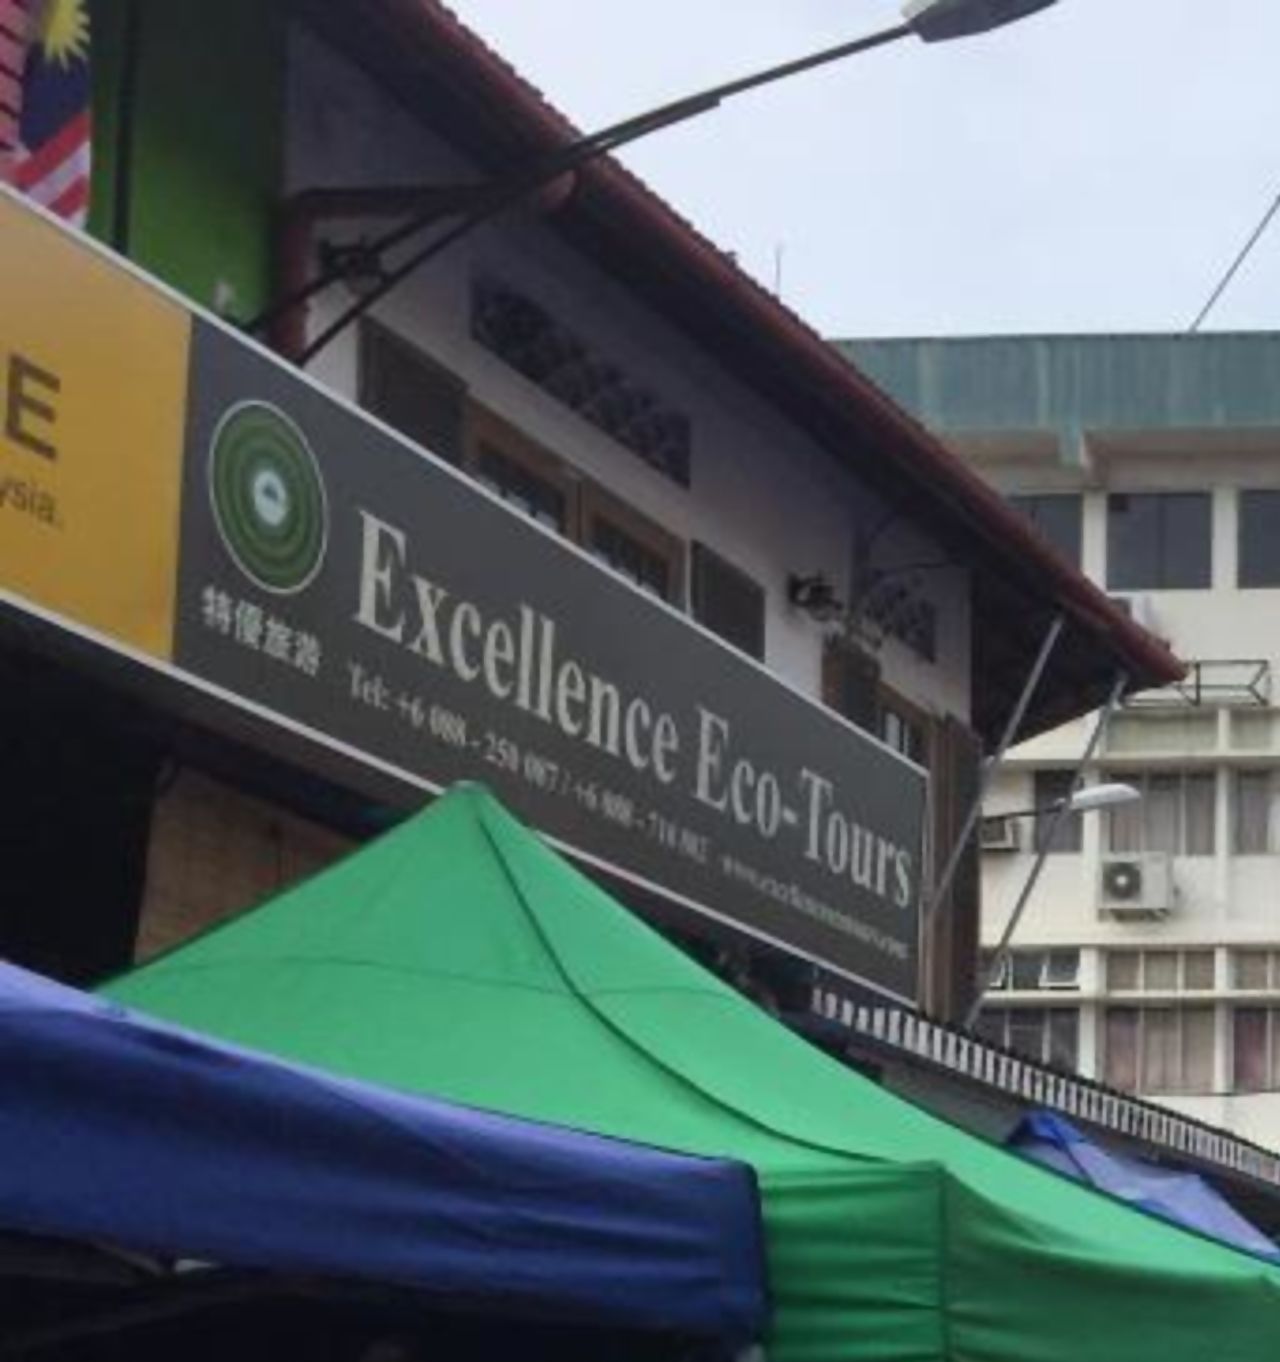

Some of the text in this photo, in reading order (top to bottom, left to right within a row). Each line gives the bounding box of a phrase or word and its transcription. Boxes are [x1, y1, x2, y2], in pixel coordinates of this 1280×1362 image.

[4, 354, 61, 463] E
[354, 509, 679, 783] Excellence
[695, 704, 912, 909] Eco-Tours
